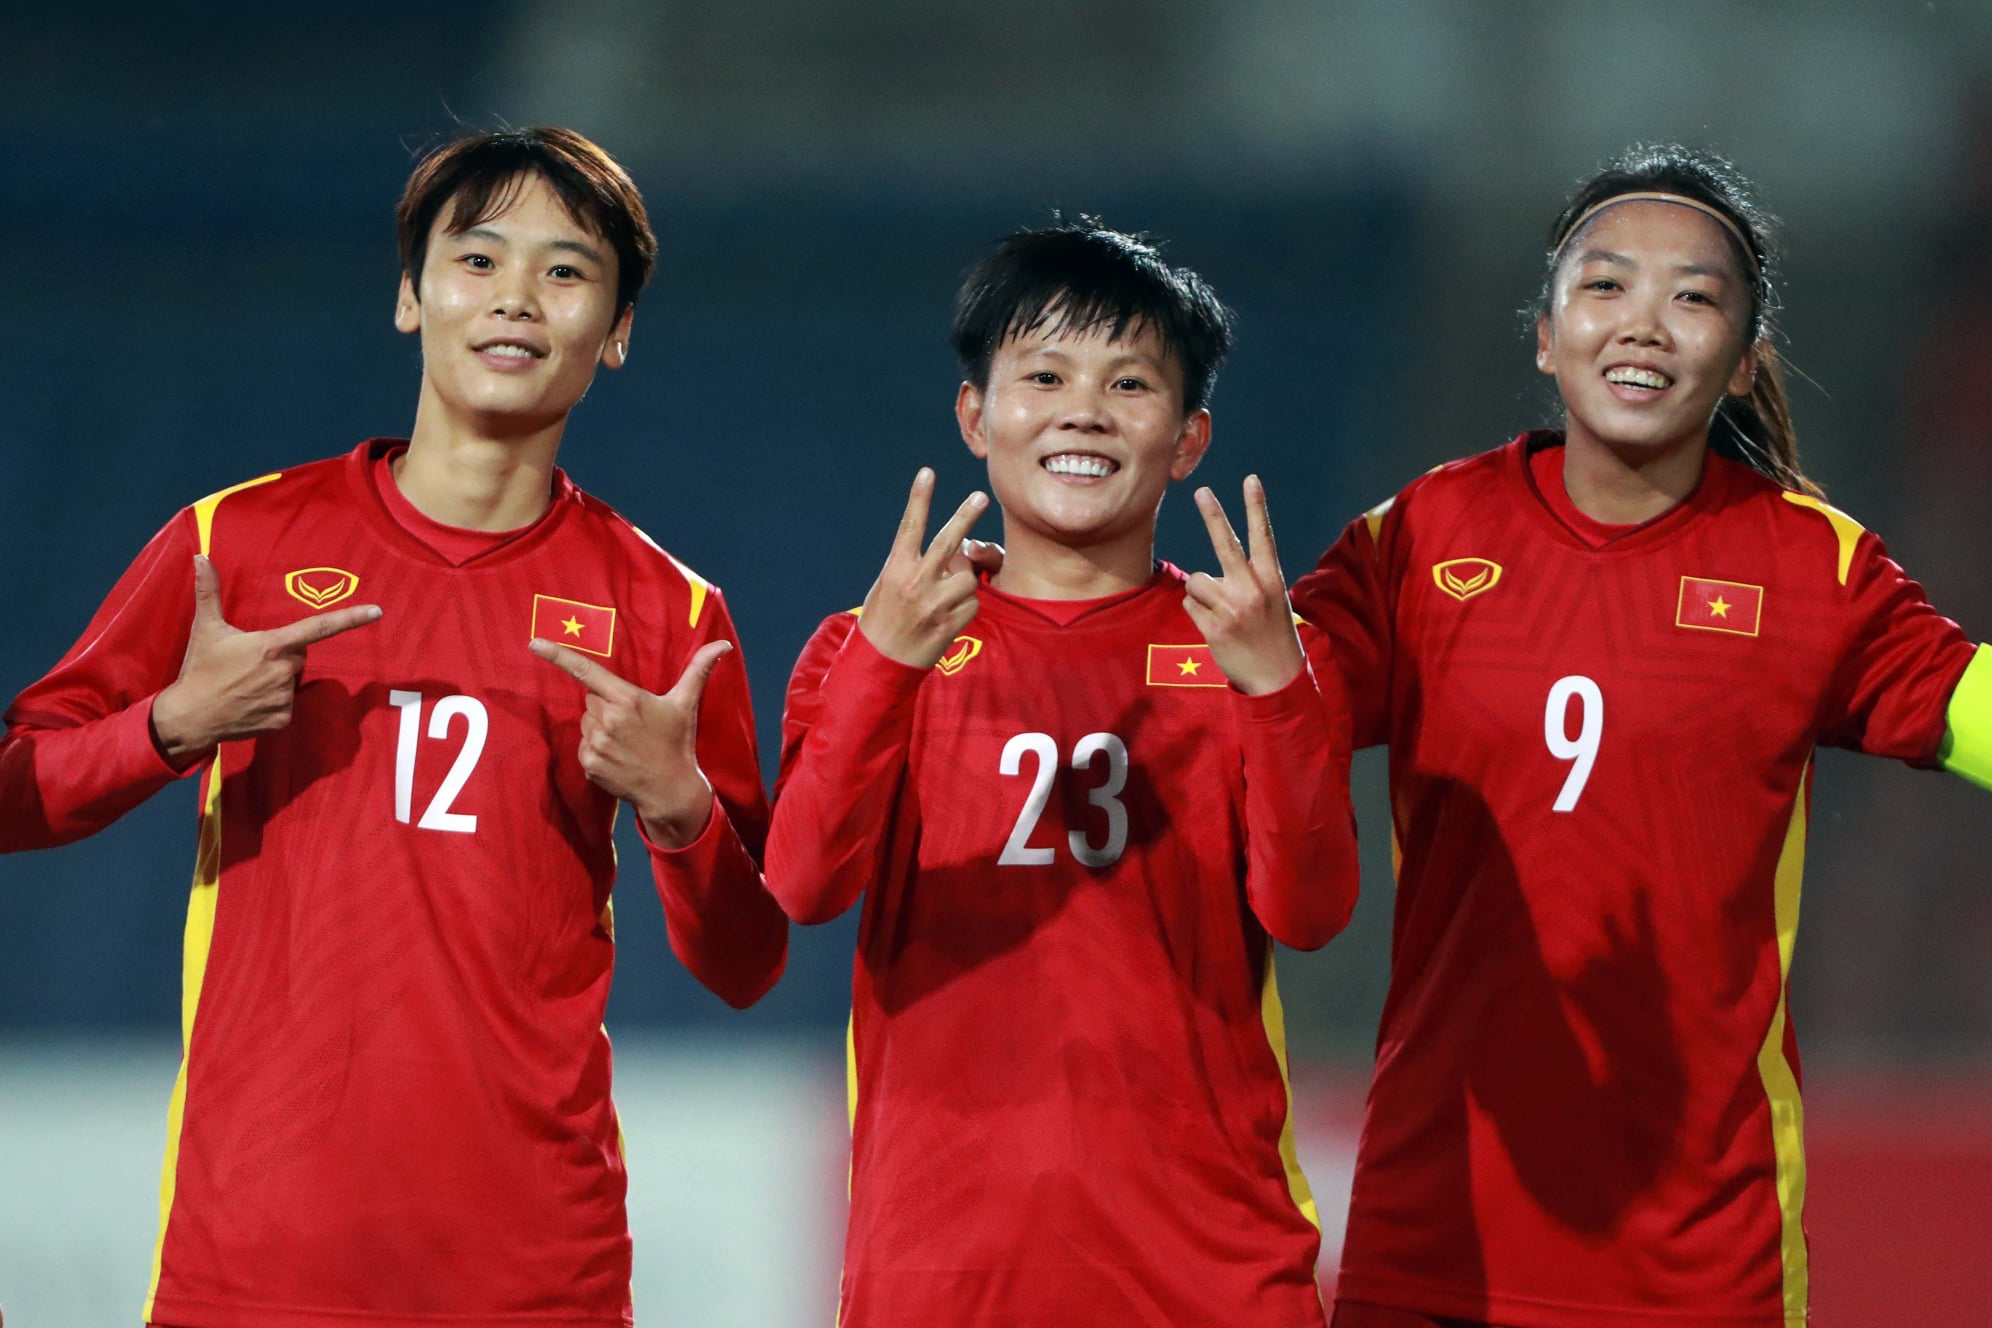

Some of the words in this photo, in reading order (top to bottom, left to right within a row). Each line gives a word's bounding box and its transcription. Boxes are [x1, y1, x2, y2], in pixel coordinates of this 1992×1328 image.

[389, 689, 489, 834] 12
[997, 732, 1128, 867] 23
[1544, 675, 1604, 812] 9
